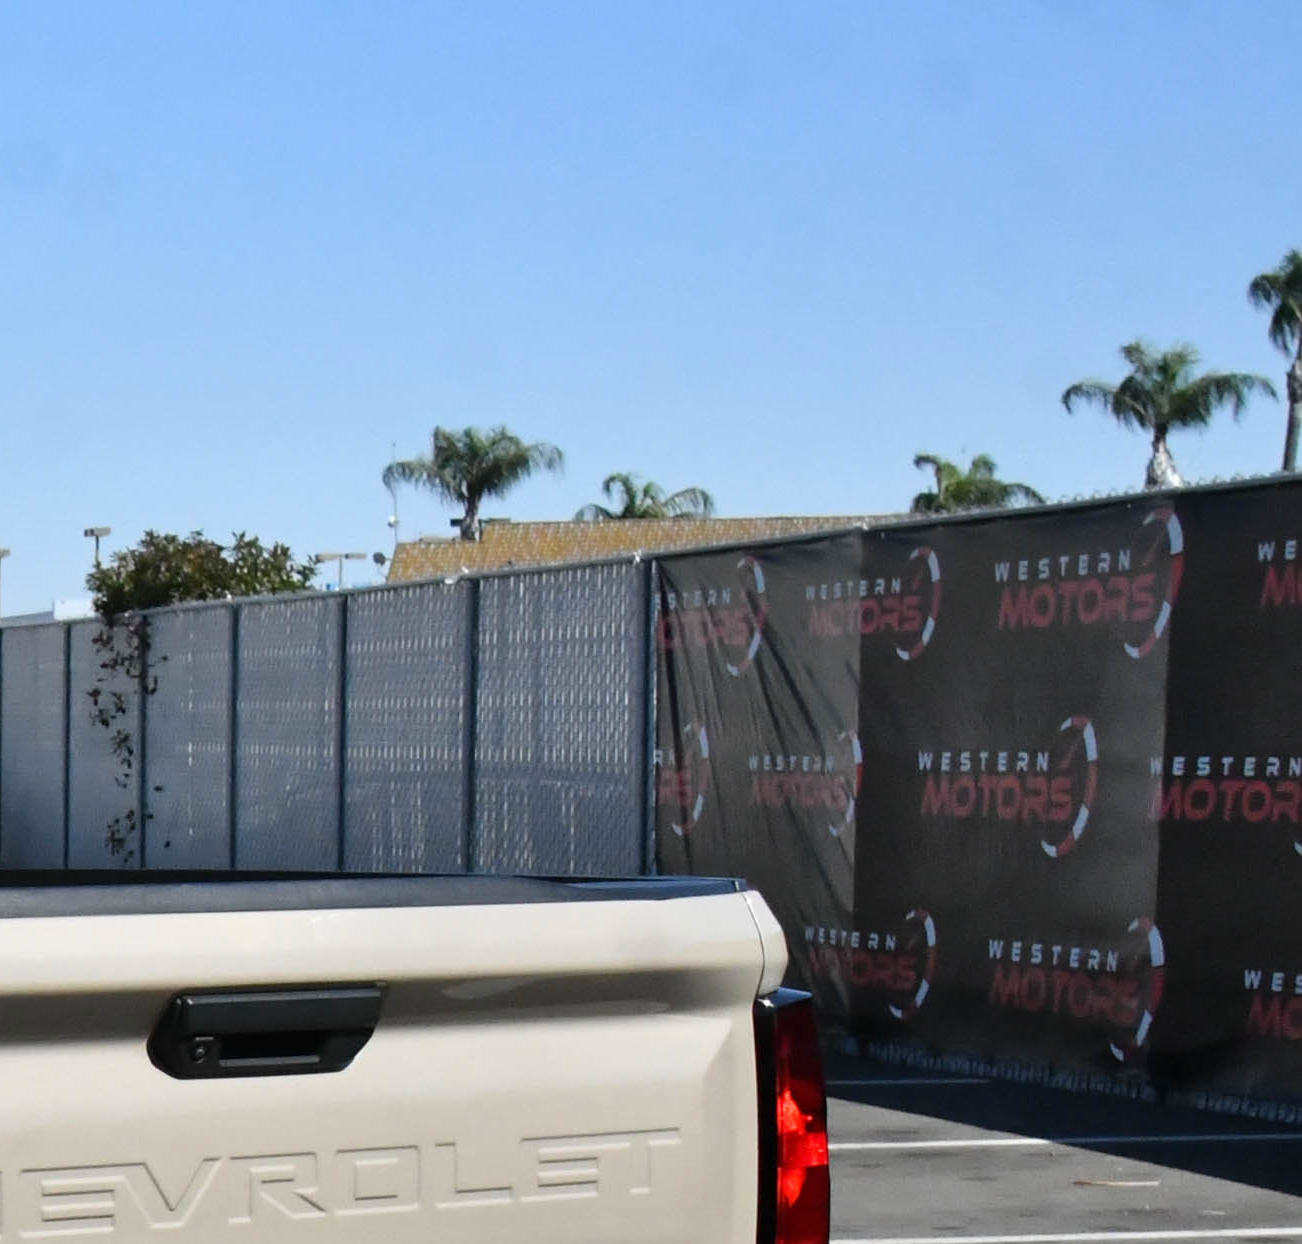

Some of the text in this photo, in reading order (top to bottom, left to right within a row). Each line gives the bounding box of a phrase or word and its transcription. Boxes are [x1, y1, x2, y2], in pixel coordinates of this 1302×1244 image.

[995, 549, 1131, 583] WESTERN
[804, 576, 901, 601] WESTERN
[997, 573, 1156, 630] MOTORS
[748, 754, 835, 774] WESTERN
[918, 750, 1049, 772] WESTERN
[1149, 756, 1302, 777] WESTERN
[921, 774, 1073, 822] MOTORS
[1147, 777, 1302, 823] MOTOR
[805, 926, 897, 952] WESTERN
[988, 938, 1119, 972] WESTERN
[990, 964, 1141, 1026] MOTORS
